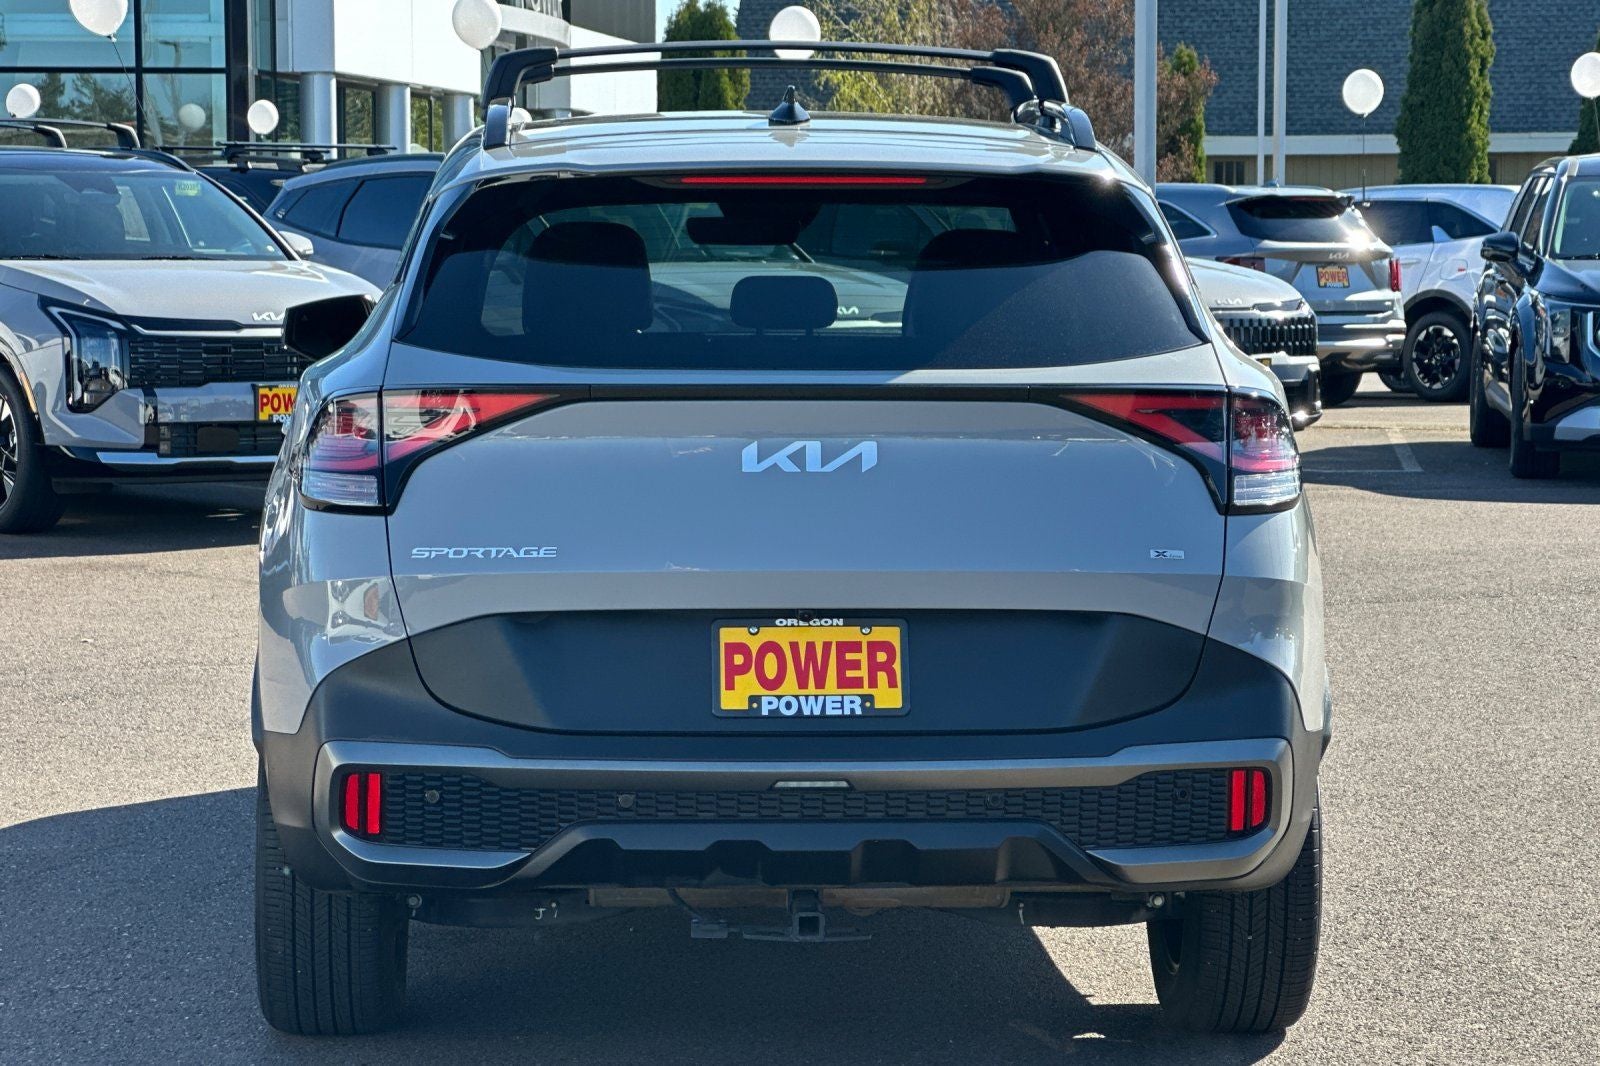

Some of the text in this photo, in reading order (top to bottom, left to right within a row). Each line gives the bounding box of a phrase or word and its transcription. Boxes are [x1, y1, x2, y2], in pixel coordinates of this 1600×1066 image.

[741, 440, 878, 473] KIA
[411, 546, 557, 559] SPORTAGE
[775, 618, 844, 627] OREGON
[723, 640, 899, 692] POWER
[761, 695, 863, 716] POWER
